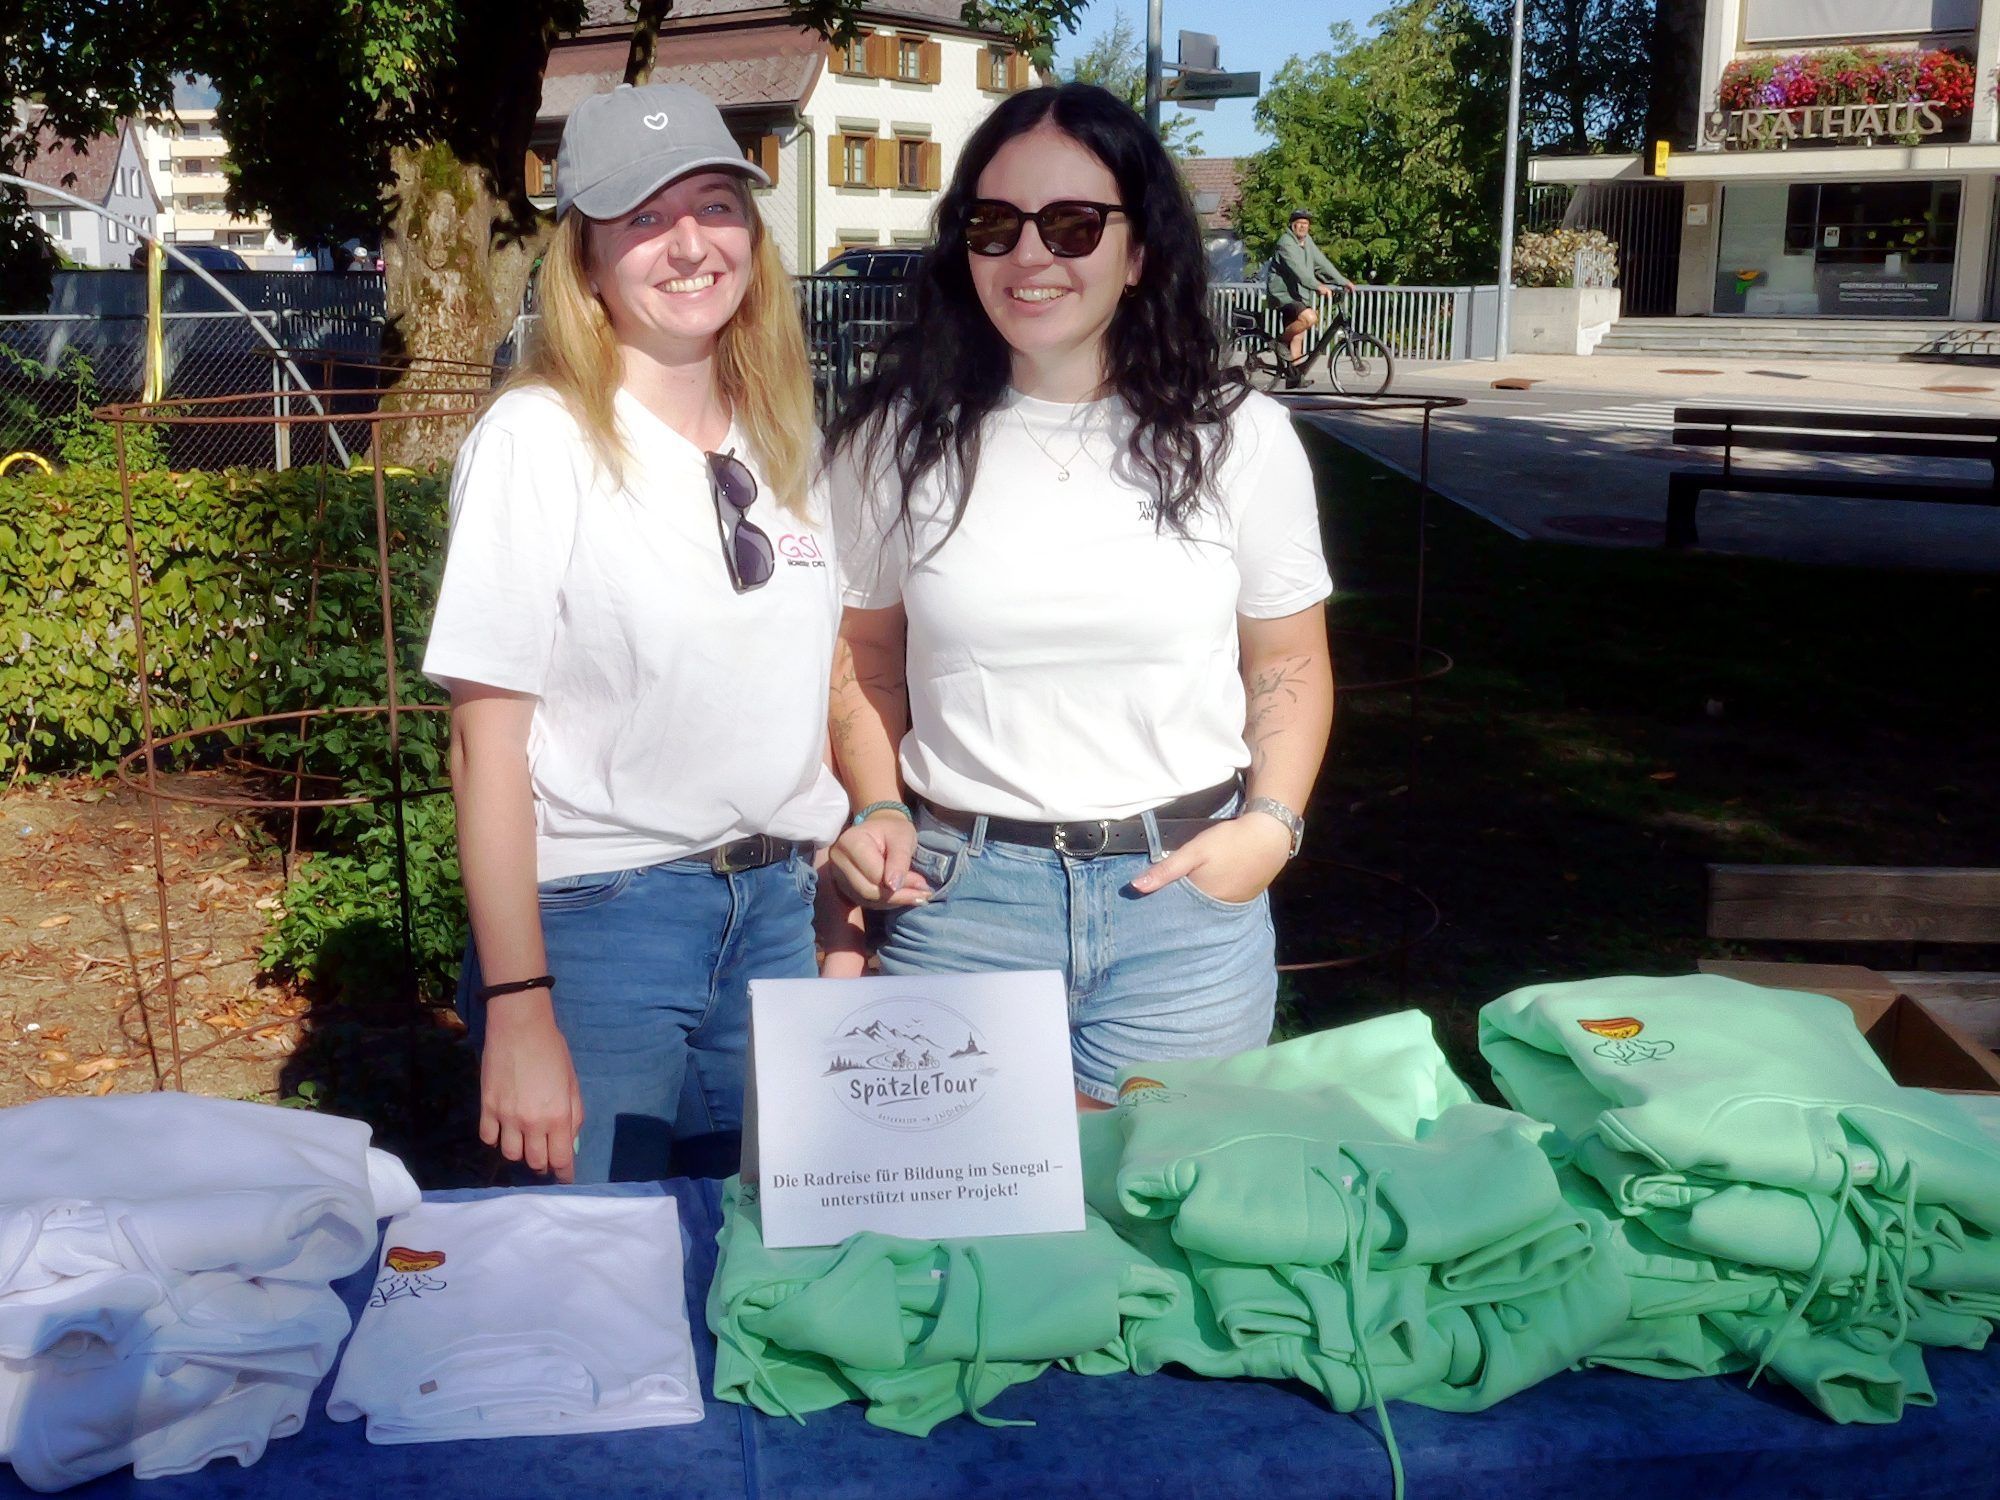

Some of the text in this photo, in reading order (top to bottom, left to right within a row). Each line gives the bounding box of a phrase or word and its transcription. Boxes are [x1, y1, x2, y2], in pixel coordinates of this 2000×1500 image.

[1741, 101, 1944, 141] RATHAUS
[850, 1072, 978, 1106] SpätzleTour
[773, 1174, 799, 1189] Die
[804, 1169, 871, 1186] Radreise
[876, 1168, 900, 1182] für
[904, 1164, 964, 1182] Bildung
[968, 1163, 988, 1177] im
[991, 1159, 1050, 1176] Senegal
[820, 1183, 1019, 1208] unterstützt unser Projekt!
